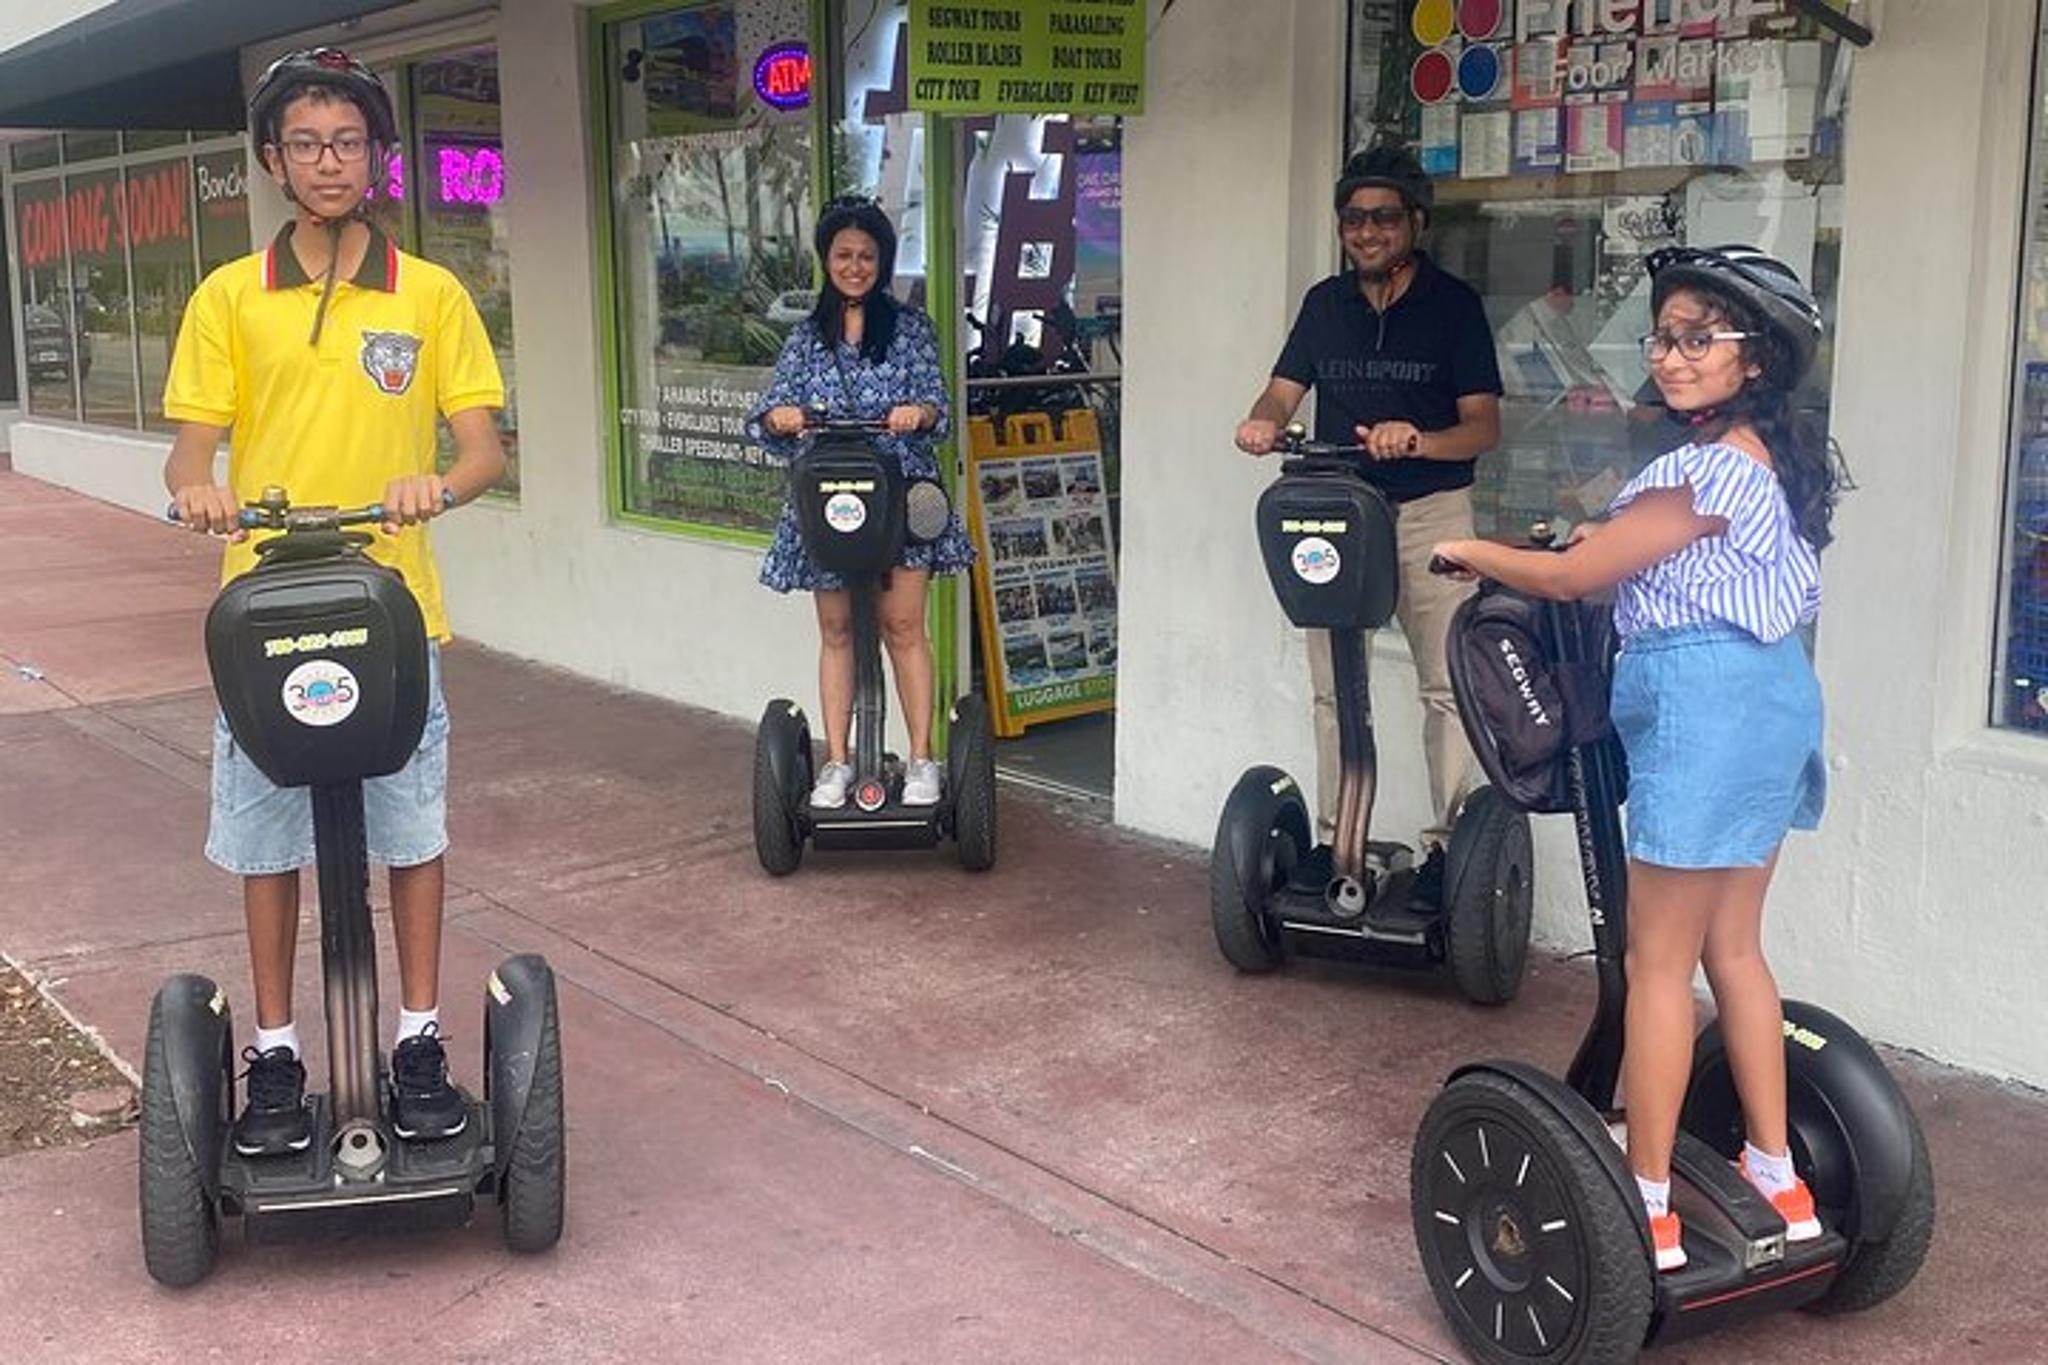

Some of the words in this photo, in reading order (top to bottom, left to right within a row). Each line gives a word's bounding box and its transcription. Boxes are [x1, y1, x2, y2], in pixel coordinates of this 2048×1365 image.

[928, 7, 977, 30] SEGWAY
[982, 10, 1021, 31] TOURS
[1050, 14, 1125, 35] PARASAILING
[927, 42, 974, 66] ROLLER
[976, 43, 1022, 67] BLADES
[1052, 46, 1082, 69] BOAT
[1085, 48, 1122, 69] TOURS
[1551, 50, 1634, 99] Food
[915, 79, 945, 100] CITY
[948, 79, 981, 100] TOUR
[998, 80, 1075, 103] EVERGLADES
[1083, 82, 1106, 103] KEY
[1109, 84, 1139, 104] WEST
[22, 182, 111, 271] COMING
[1499, 639, 1551, 725] SEGWAY
[1017, 683, 1081, 708] LUGGAGE
